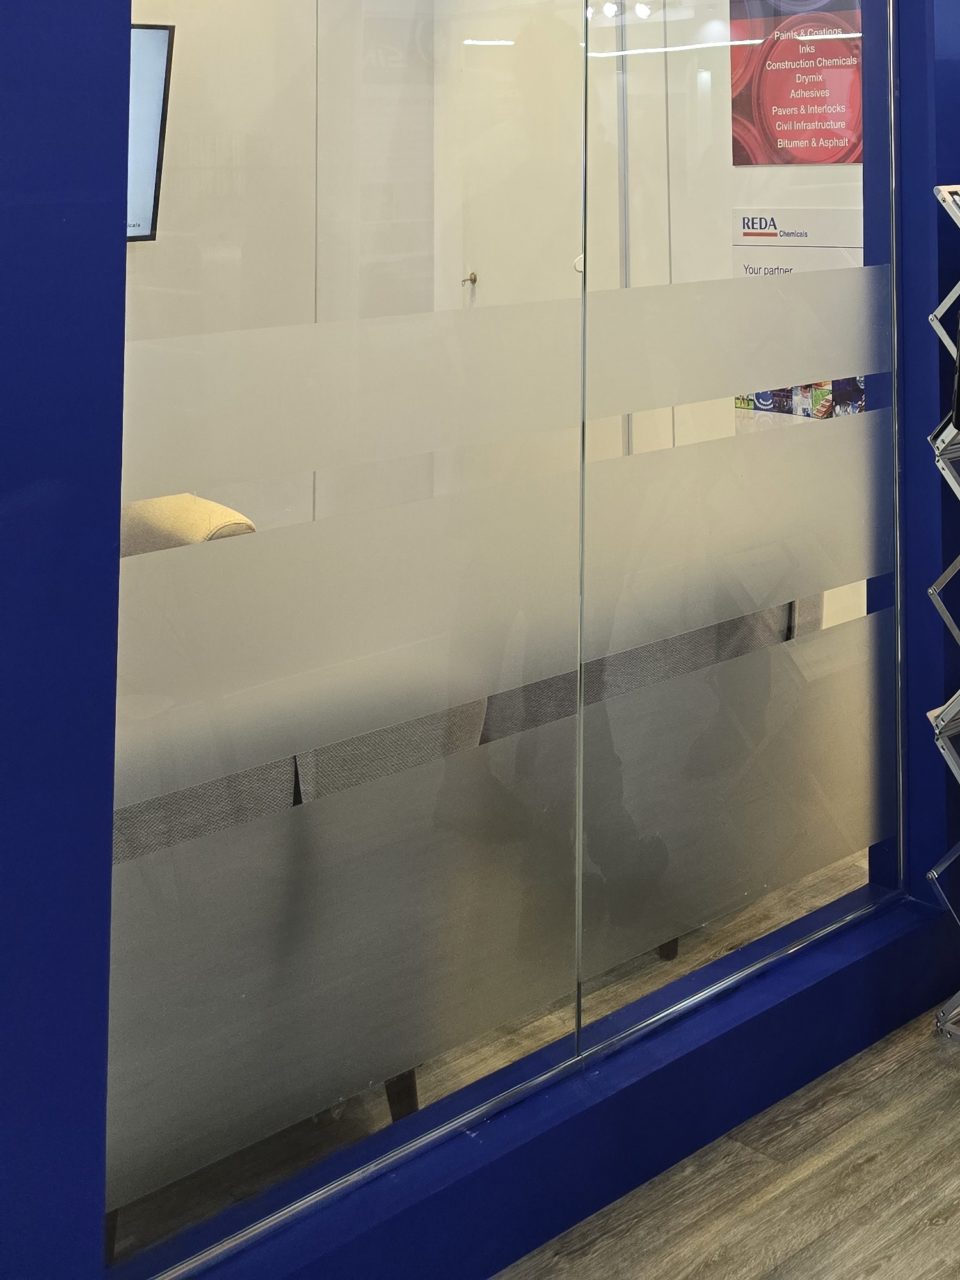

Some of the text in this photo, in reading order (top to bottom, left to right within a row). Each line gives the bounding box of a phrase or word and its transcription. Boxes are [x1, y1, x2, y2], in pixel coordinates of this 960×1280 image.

[774, 30, 799, 41] Paints
[799, 44, 816, 54] Inks
[766, 55, 858, 71] Construction Chemicals
[795, 73, 823, 85] Drymix
[790, 88, 830, 99] Adhesives
[772, 103, 846, 116] Pavers & Interlocks
[776, 119, 846, 131] Civil Infrastructure
[777, 137, 849, 149] Bitumen & Asphalt
[742, 216, 778, 230] REDA
[779, 230, 808, 238] Chemicals
[743, 264, 793, 276] Your partner
